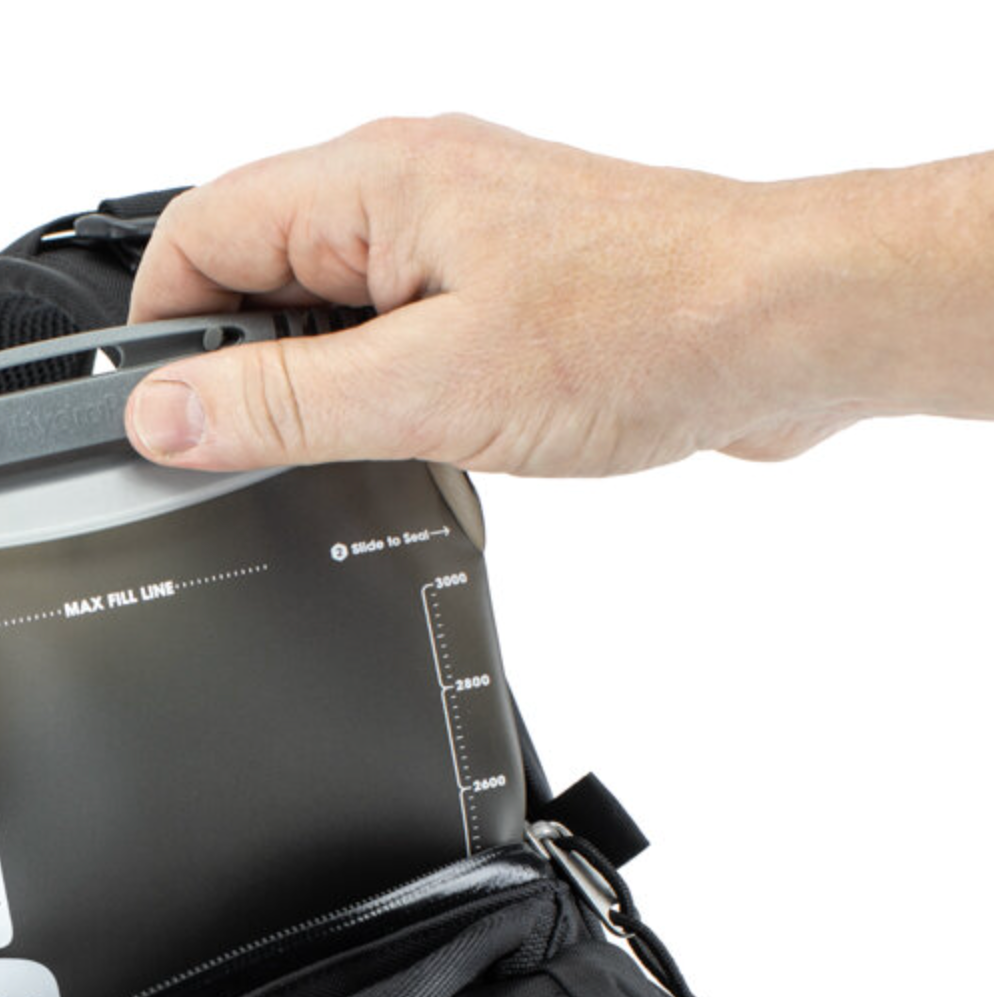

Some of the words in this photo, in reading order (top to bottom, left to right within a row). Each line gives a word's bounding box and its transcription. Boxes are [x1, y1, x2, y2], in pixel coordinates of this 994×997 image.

[351, 540, 384, 555] Slide
[387, 536, 401, 547] to
[403, 530, 429, 544] Seal
[434, 572, 468, 589] 3000
[64, 595, 105, 618] MAX
[107, 589, 138, 608] FILL
[140, 580, 176, 601] LINE
[455, 674, 491, 691] 2800
[473, 774, 506, 791] 2600
